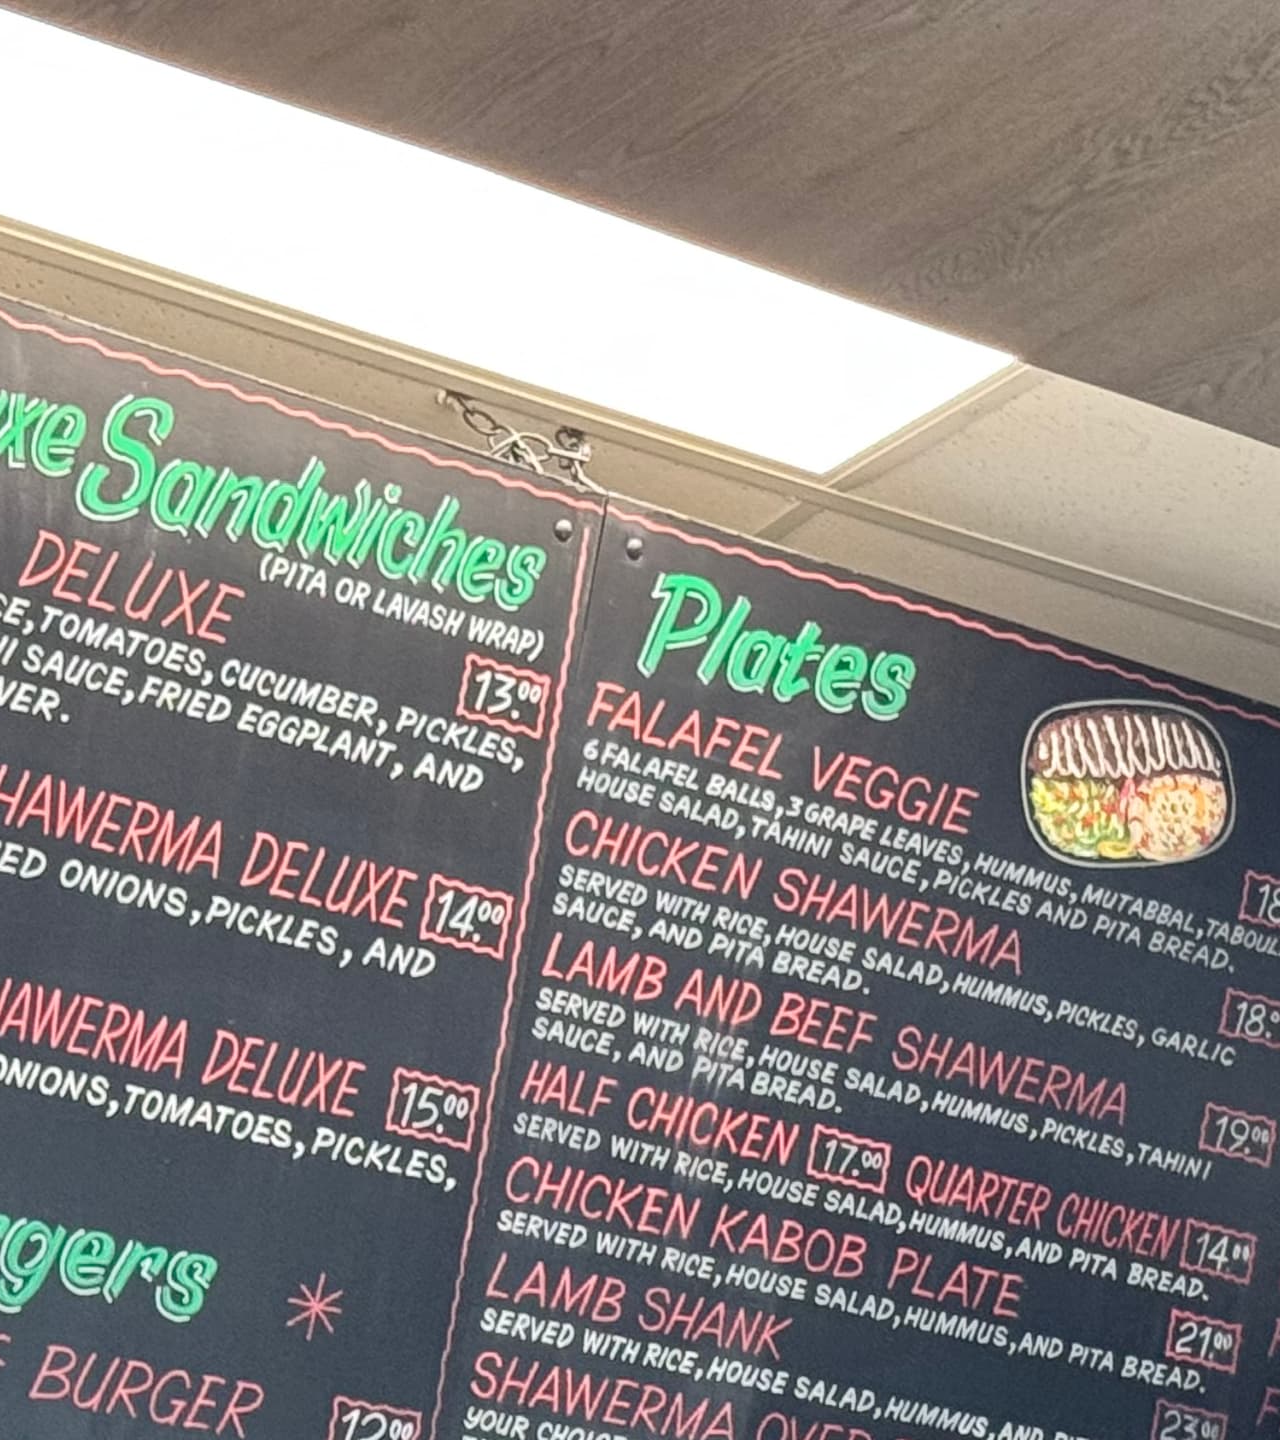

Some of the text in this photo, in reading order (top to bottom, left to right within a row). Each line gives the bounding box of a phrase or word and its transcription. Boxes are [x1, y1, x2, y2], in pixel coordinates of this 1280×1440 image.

[75, 395, 547, 612] Sandwiches
[17, 528, 247, 645] DELUXE
[258, 551, 546, 663] (PITA OR LAVASH WRAP)
[637, 573, 918, 721] Plates
[21, 643, 136, 707] SAUCE,
[137, 674, 233, 724] FRIED
[235, 701, 405, 781] EGGPLANT,
[412, 751, 485, 794] AND
[39, 604, 215, 688] TOMATOES,
[219, 657, 389, 738] CUCUMBER,
[394, 704, 525, 774] PICKLES,
[585, 680, 980, 835] FALAFEL VEGGIE
[58, 858, 203, 927] ONIONS,
[203, 894, 354, 969] PICKLES,
[361, 936, 437, 979] AND
[238, 830, 420, 929] DELUXE
[563, 808, 1022, 977] CHICKEN SHAWERMA
[557, 862, 1237, 1068] SERVED WITH RICE, HOUSE SALAD, HUMMUS, PICKLES, GARLIC
[200, 1028, 368, 1118] DELUXE
[540, 930, 1127, 1126] LAMB AND BEEF SHAWERMA
[123, 1083, 307, 1161] TOMATOES,
[310, 1125, 458, 1193] PICKLES,
[519, 1058, 801, 1167] HALF CHICKEN
[504, 1154, 1024, 1319] CHICKEN KABOB PLATE
[904, 1154, 1182, 1260] QUARTER CHICKEN
[484, 1251, 794, 1361] LAMB SHANK
[28, 1343, 266, 1440] BURGER
